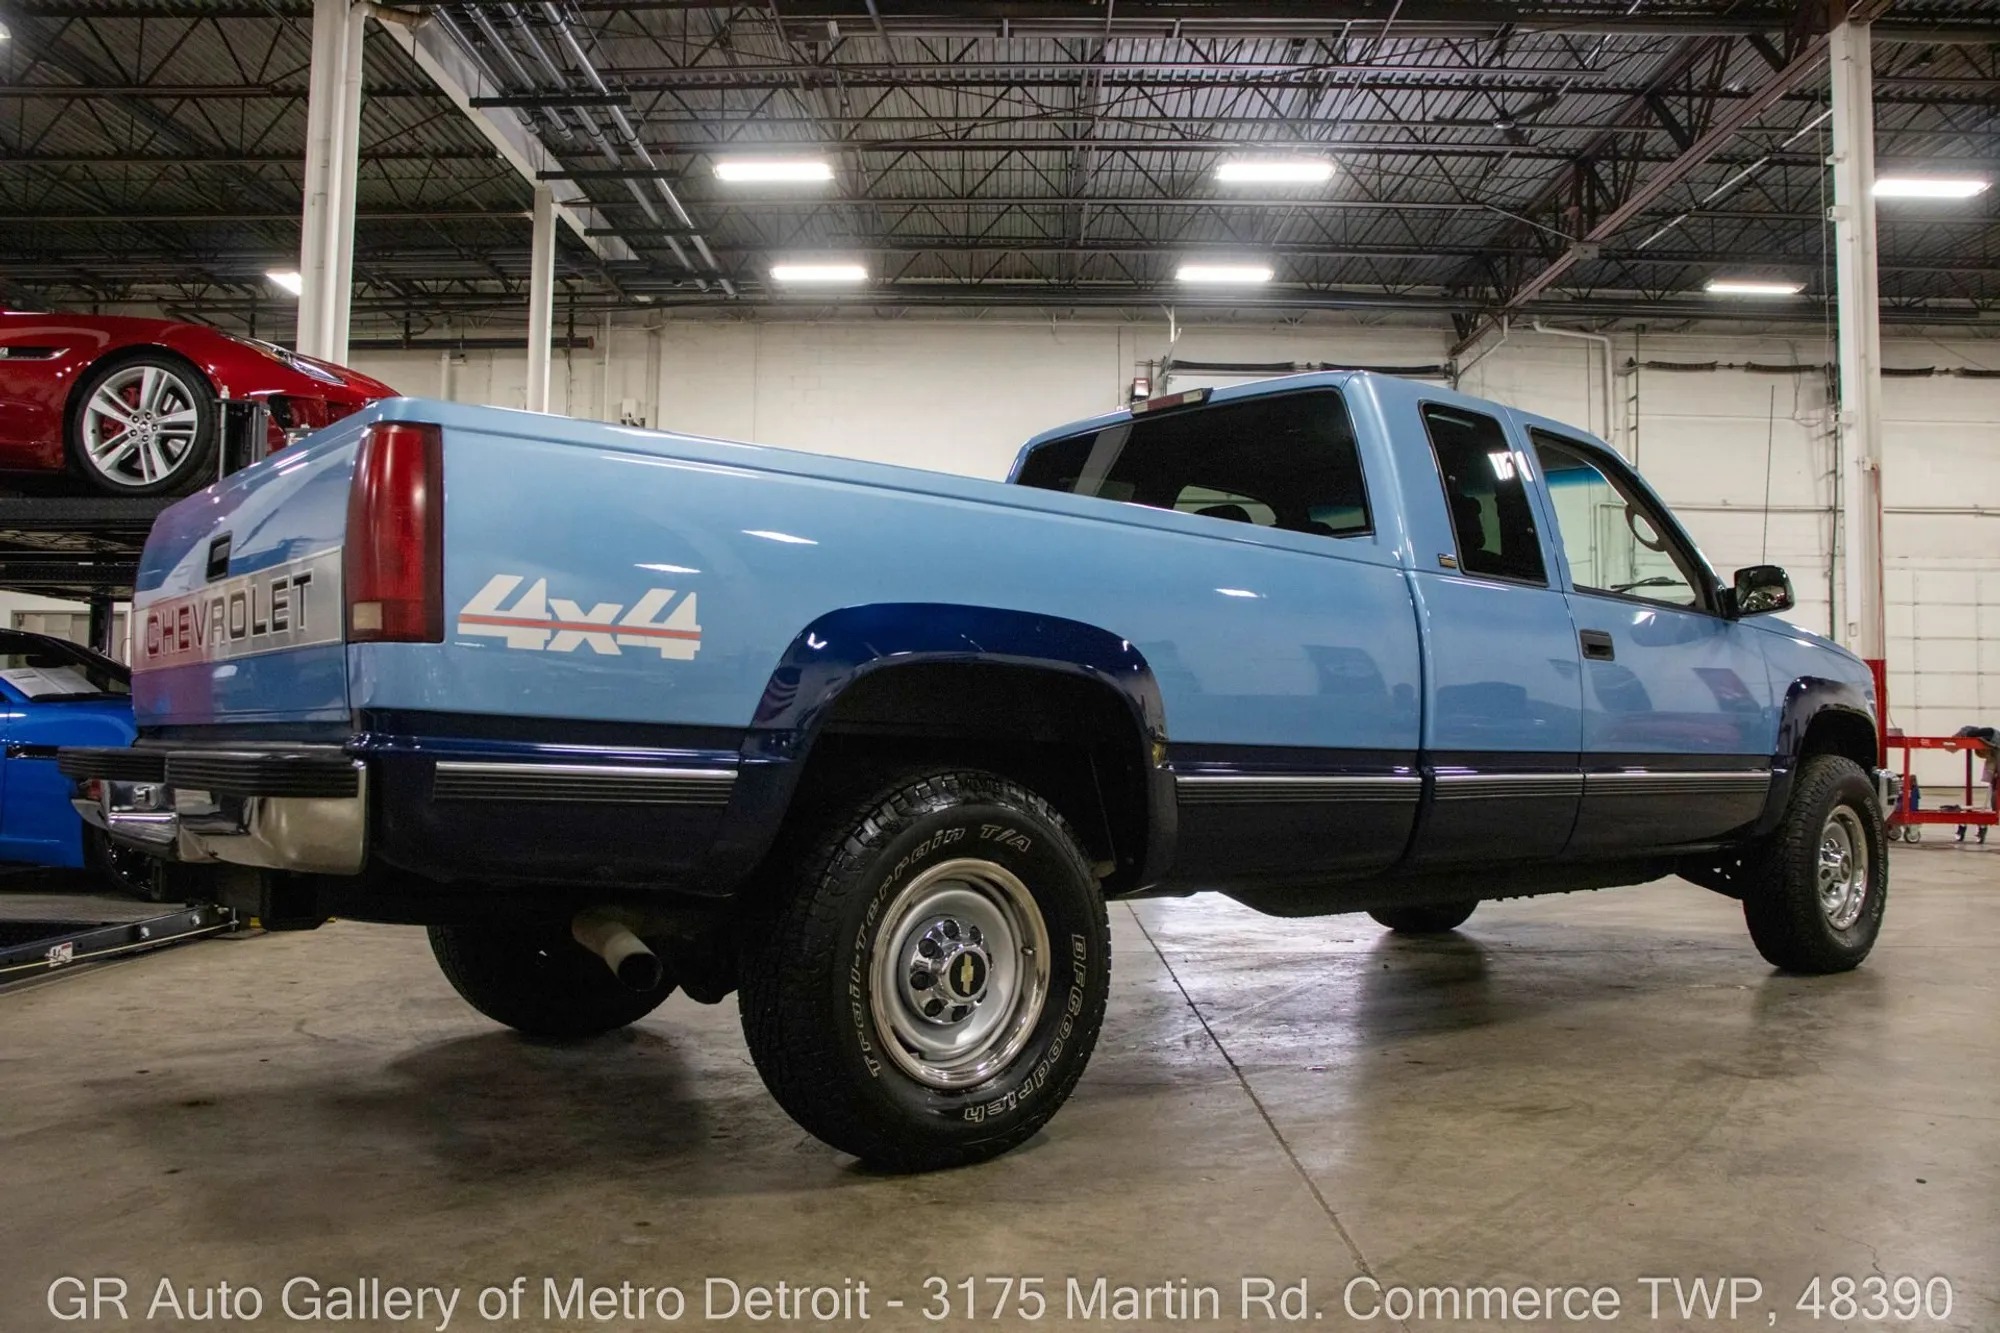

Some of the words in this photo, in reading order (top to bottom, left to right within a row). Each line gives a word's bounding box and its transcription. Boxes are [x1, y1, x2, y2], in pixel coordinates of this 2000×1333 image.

[146, 568, 314, 657] CHEVROLET
[979, 823, 1032, 852] T/A
[963, 933, 1087, 1123] BFGoodrich
